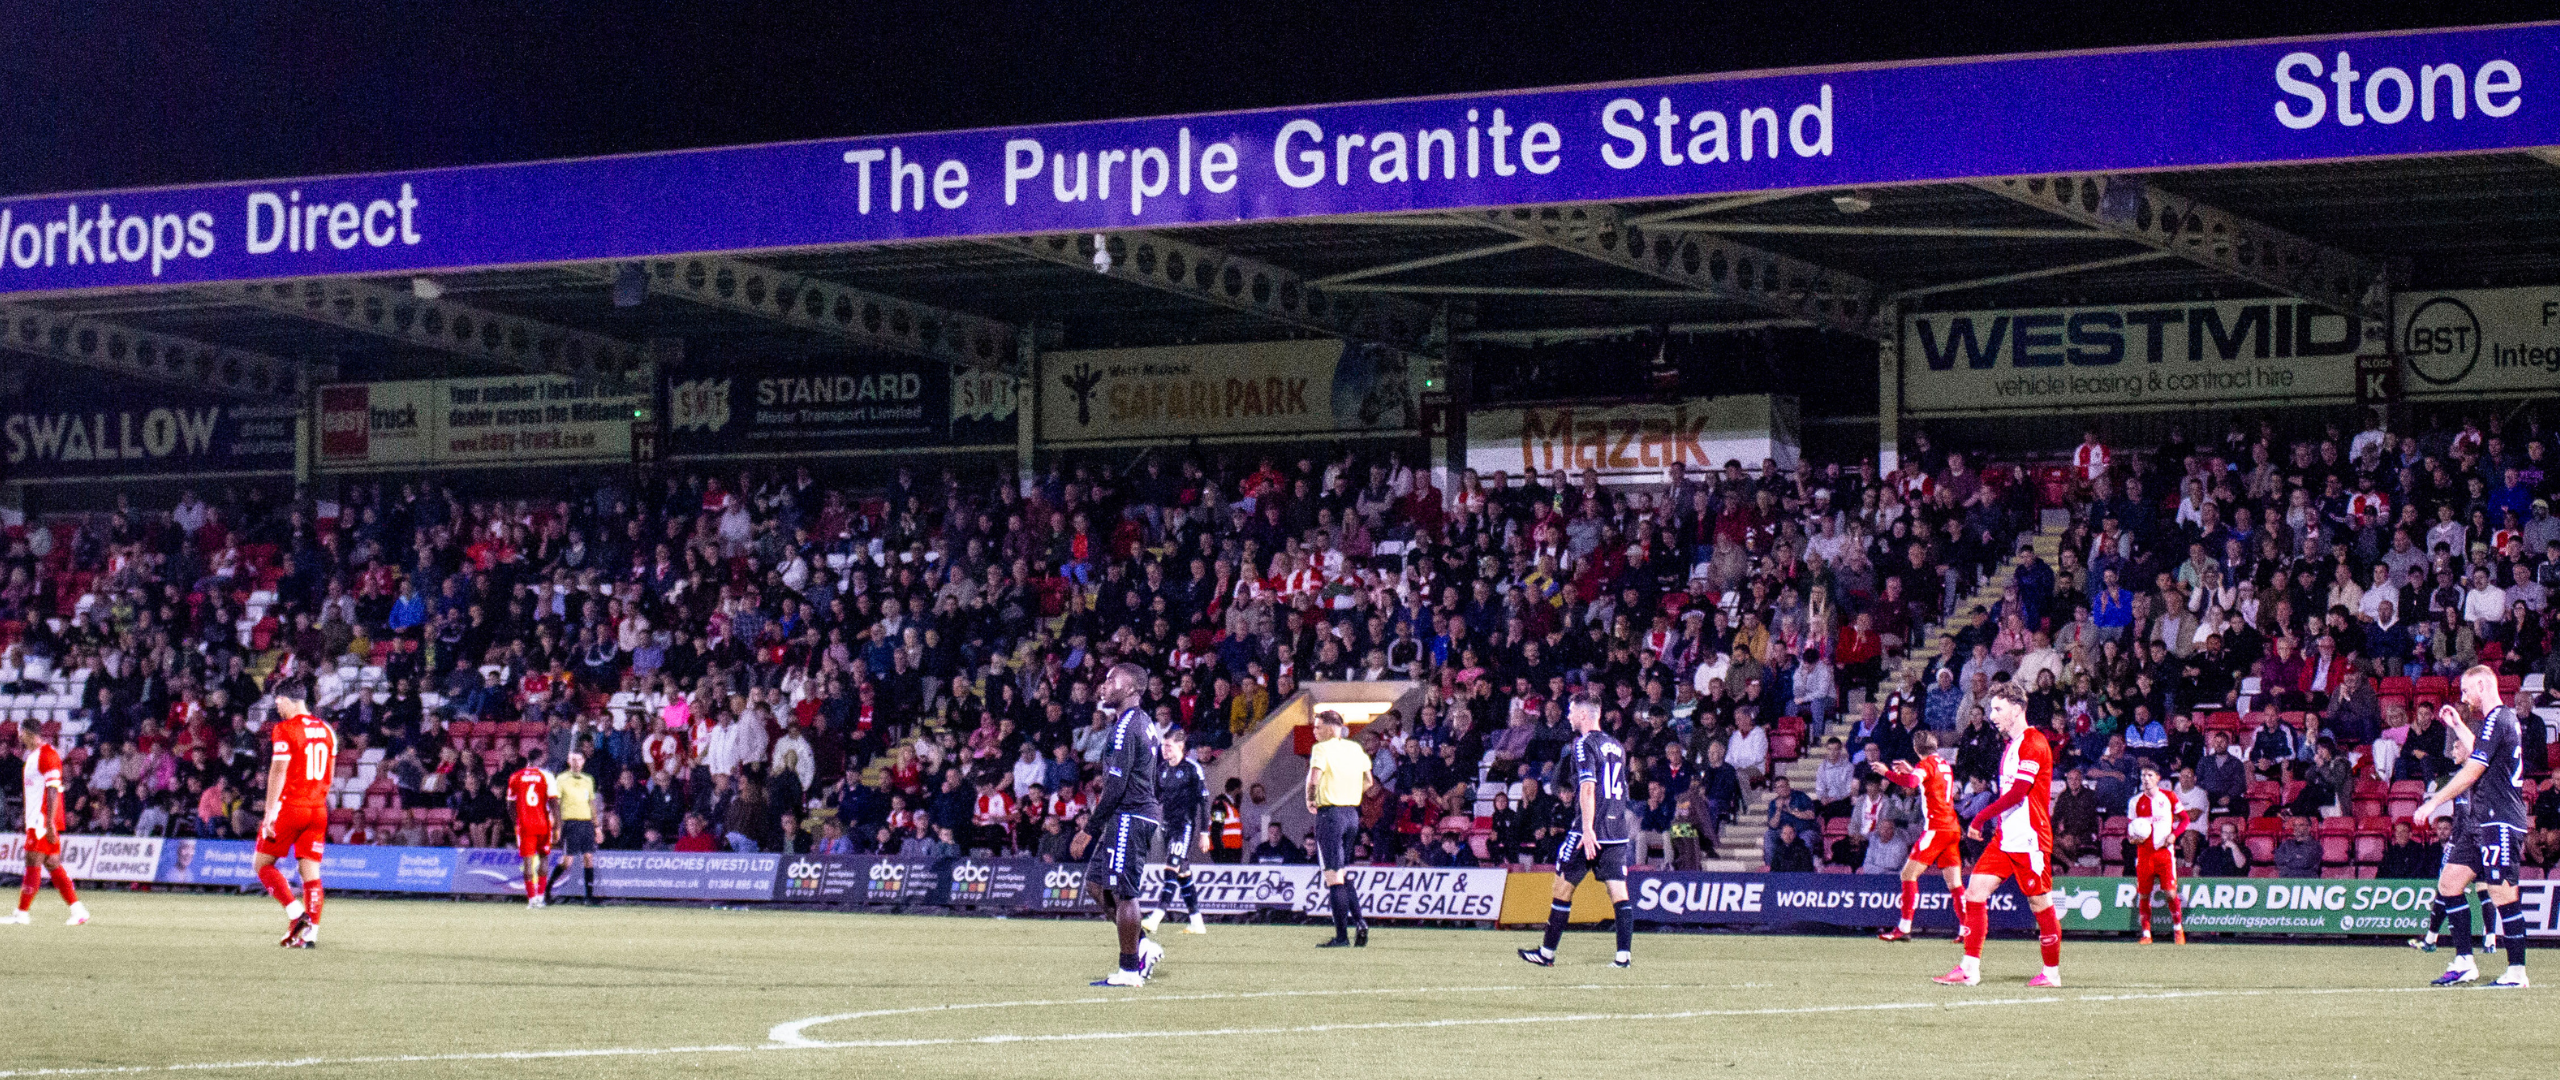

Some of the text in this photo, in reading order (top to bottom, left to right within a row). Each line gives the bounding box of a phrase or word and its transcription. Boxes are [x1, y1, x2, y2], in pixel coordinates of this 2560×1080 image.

[2275, 51, 2522, 130] Stone
[844, 84, 1832, 216] The Purple Granite Stand
[0, 182, 421, 269] orktops Direct
[1917, 304, 2361, 371] WESTMID
[2413, 325, 2471, 355] BST
[2360, 357, 2393, 369] BLOCK
[755, 372, 921, 406] STANDARD
[1995, 367, 2294, 398] vehicle leasing & contract hire
[2365, 373, 2388, 399] K
[323, 403, 419, 438] easy truck
[799, 407, 867, 424] Transport
[869, 404, 923, 420] Limited
[1432, 409, 1446, 434] J
[4, 405, 220, 464] SWALLOW
[1520, 407, 1713, 470] Mazak
[638, 437, 656, 460] H
[304, 741, 329, 781] 10
[1603, 761, 1624, 801] 14
[1942, 773, 1954, 803] 7
[525, 783, 540, 807] 6
[99, 841, 154, 858] SIGNS &
[1106, 847, 1116, 870] 7
[1170, 841, 1183, 856] 10
[2481, 844, 2502, 868] 27
[96, 860, 152, 875] GRAPHICS
[645, 856, 705, 872] COACHES
[705, 857, 749, 874] (WEST)
[749, 858, 775, 872] LTD
[787, 856, 823, 879] ebc
[869, 858, 905, 881] ebc
[952, 859, 991, 882] ebc
[1044, 864, 1082, 888] ebc
[1193, 870, 1261, 885] DAM
[1369, 871, 1449, 892] PLANT
[1452, 873, 1468, 893] &
[785, 889, 815, 897] group
[867, 891, 898, 899] group
[950, 893, 984, 901] group
[1042, 899, 1075, 908] group
[1637, 878, 1765, 915] SQUIRE
[1775, 890, 1855, 909] WORLD'S
[2265, 883, 2347, 911] DING
[1415, 895, 1494, 916] SALES
[2355, 916, 2391, 928] 07733
[2393, 916, 2419, 928] 004
